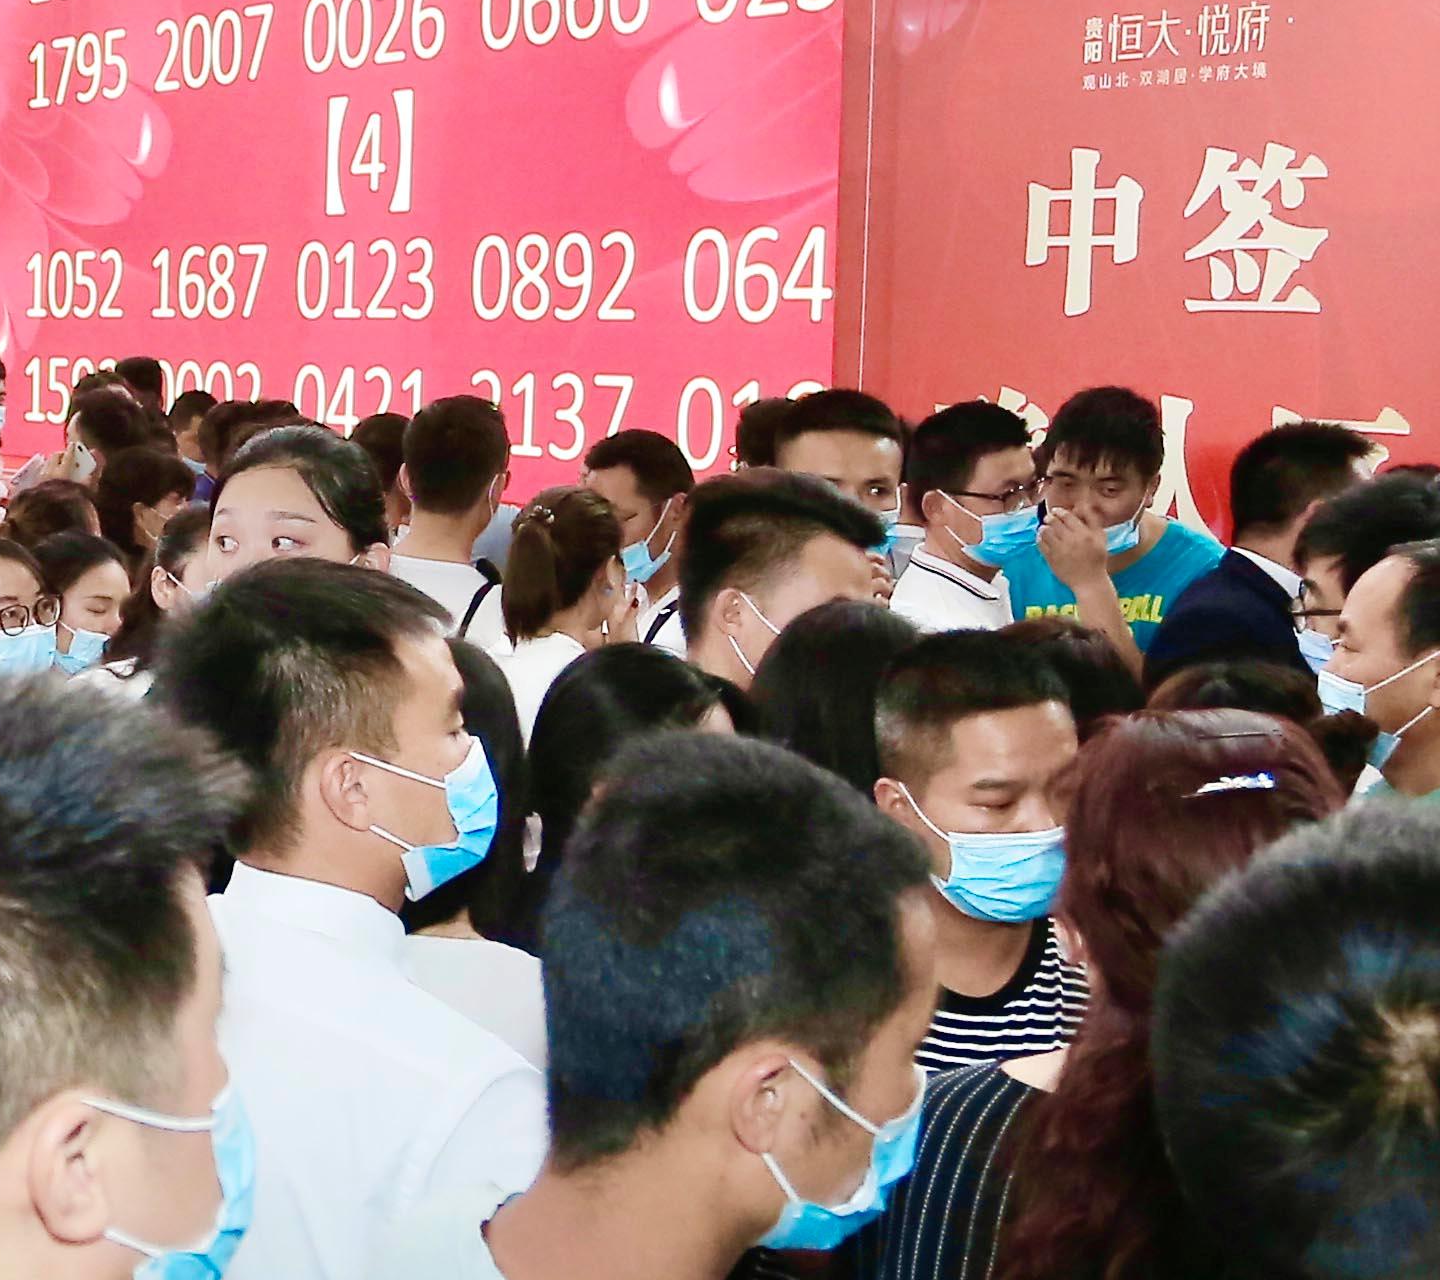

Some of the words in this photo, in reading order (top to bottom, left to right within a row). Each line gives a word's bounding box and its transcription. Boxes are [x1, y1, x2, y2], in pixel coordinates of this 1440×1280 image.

[28, 28, 129, 109] 1795
[154, 3, 274, 92] 2007
[26, 248, 124, 319] 1052
[151, 244, 268, 319] 1687
[296, 237, 434, 320] 0123
[472, 231, 636, 321] 0892
[1026, 144, 1329, 318] 中签
